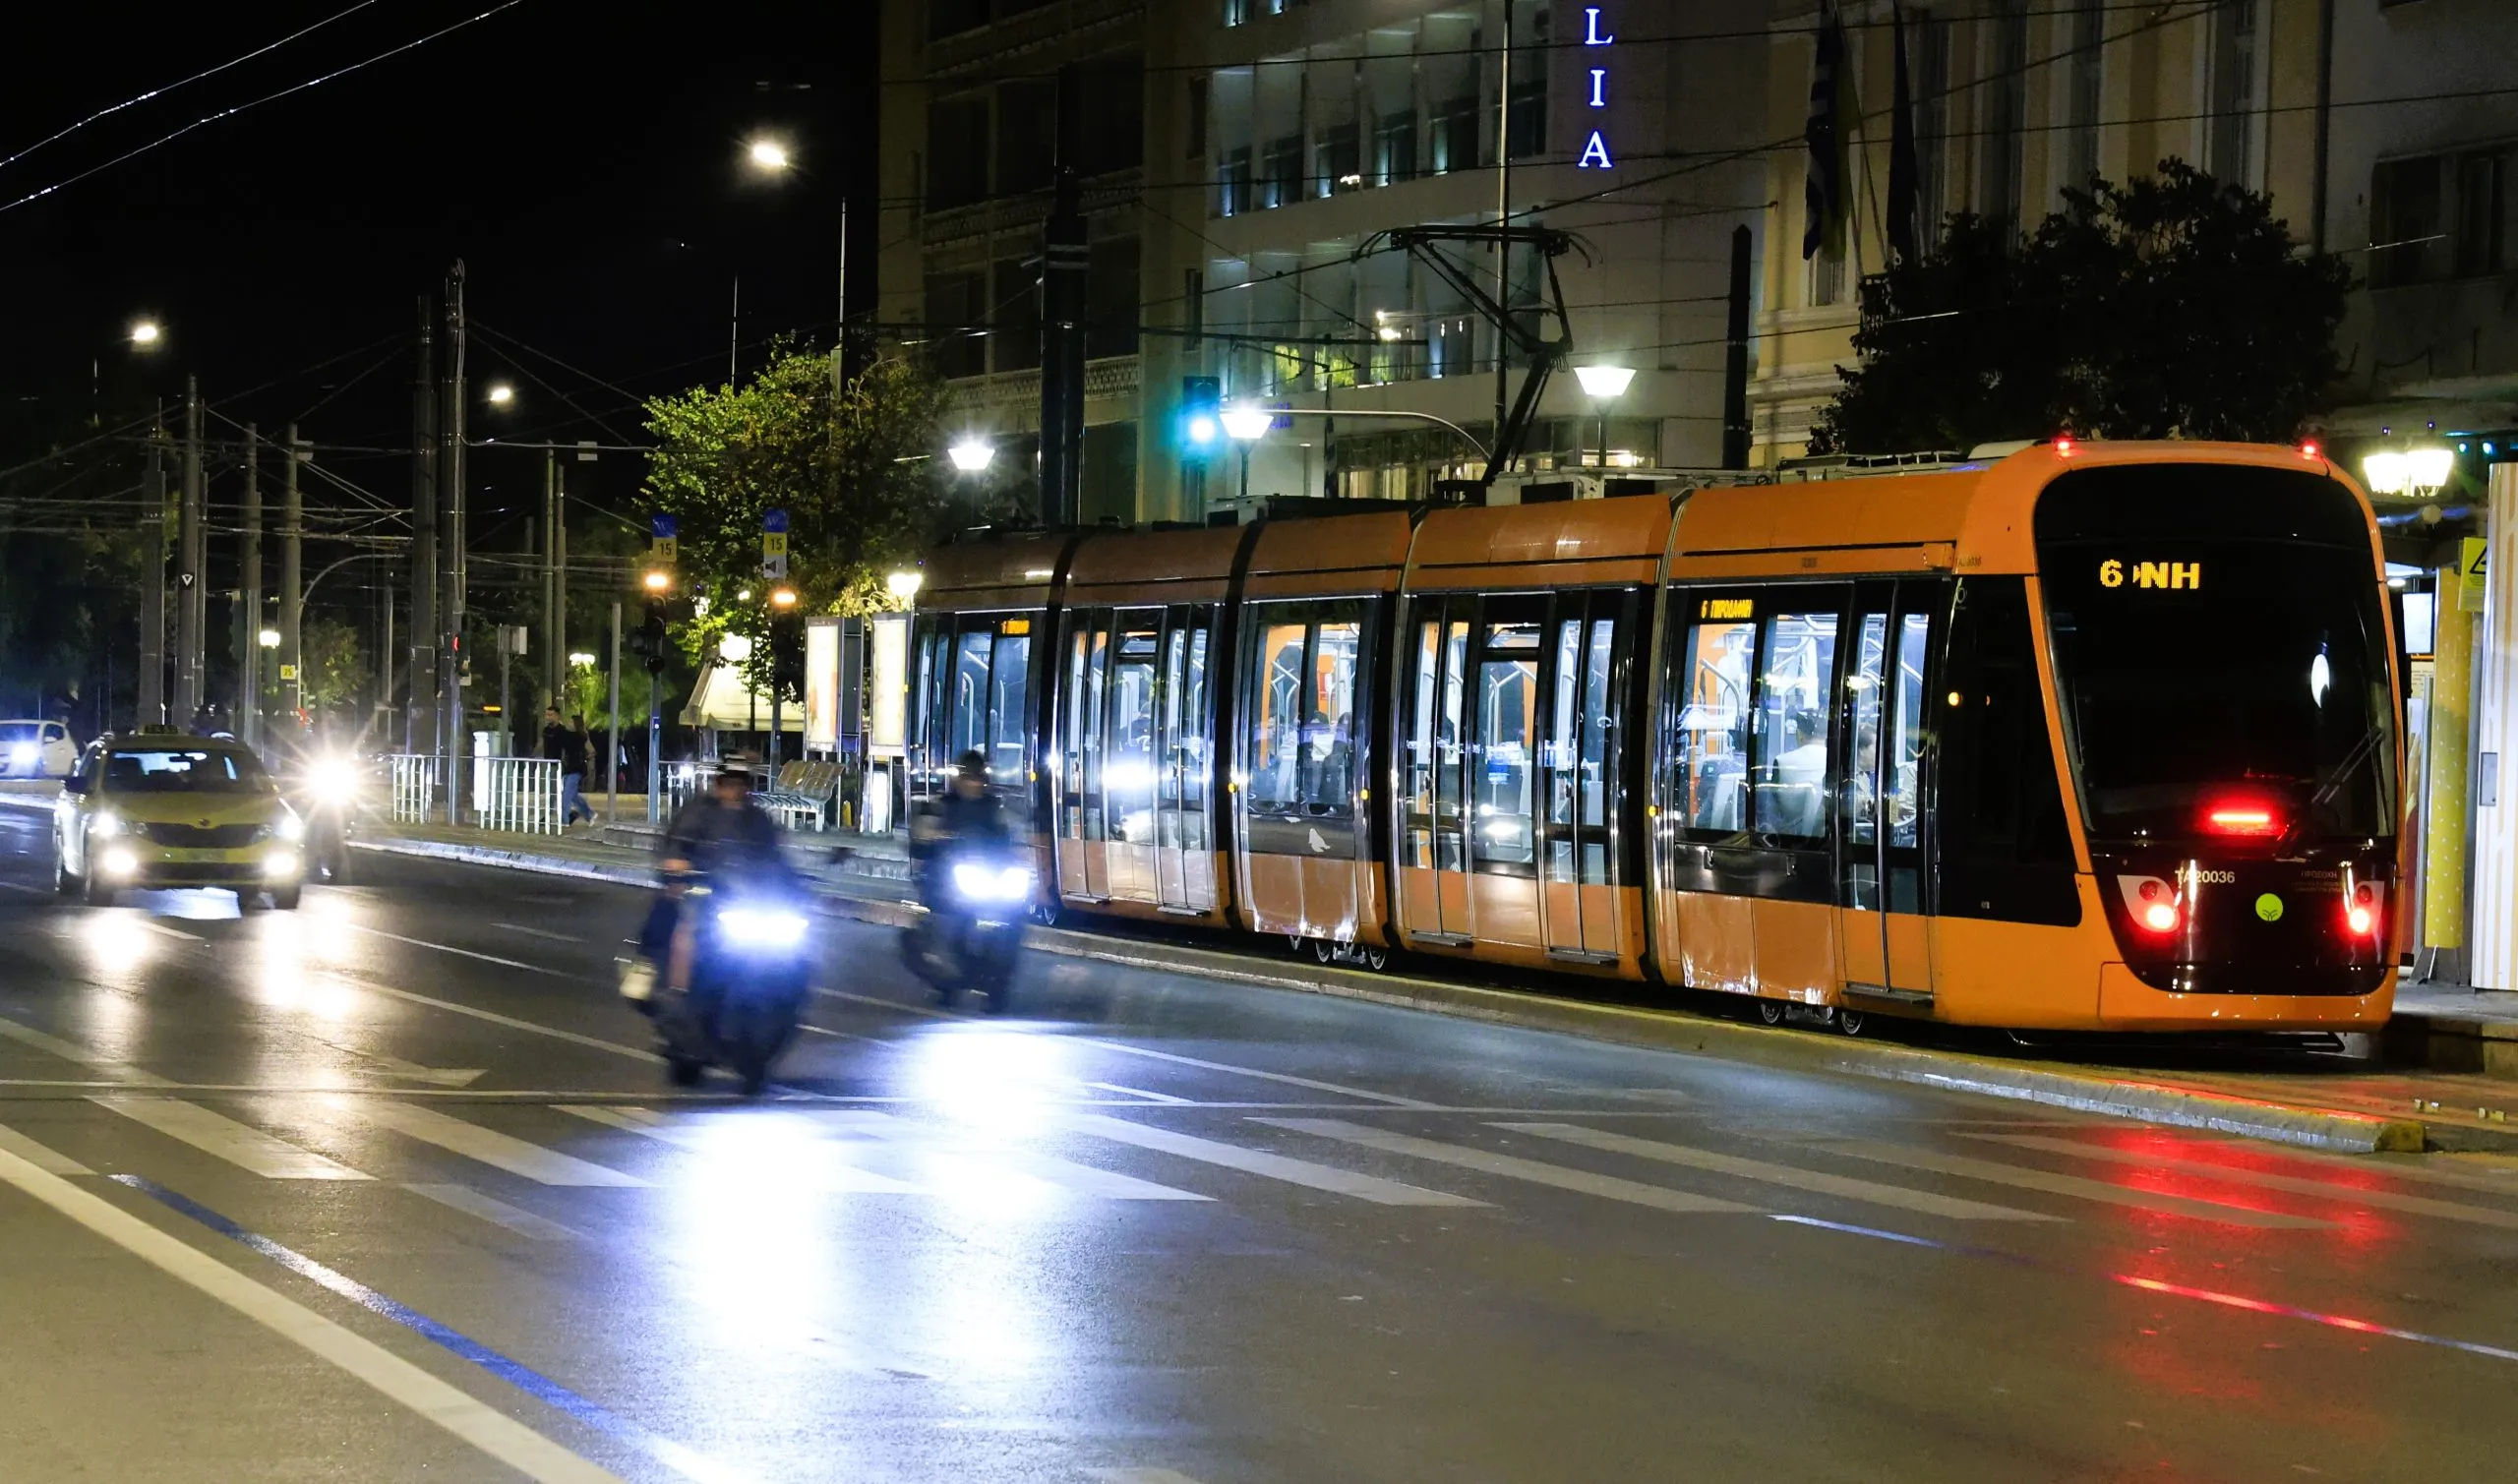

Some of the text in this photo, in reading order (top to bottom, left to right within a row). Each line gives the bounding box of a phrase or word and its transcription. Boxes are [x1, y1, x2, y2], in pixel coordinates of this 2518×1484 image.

[1578, 8, 1613, 168] LIA
[660, 543, 672, 556] 15
[771, 538, 782, 551] 15
[2100, 559, 2123, 587] 6
